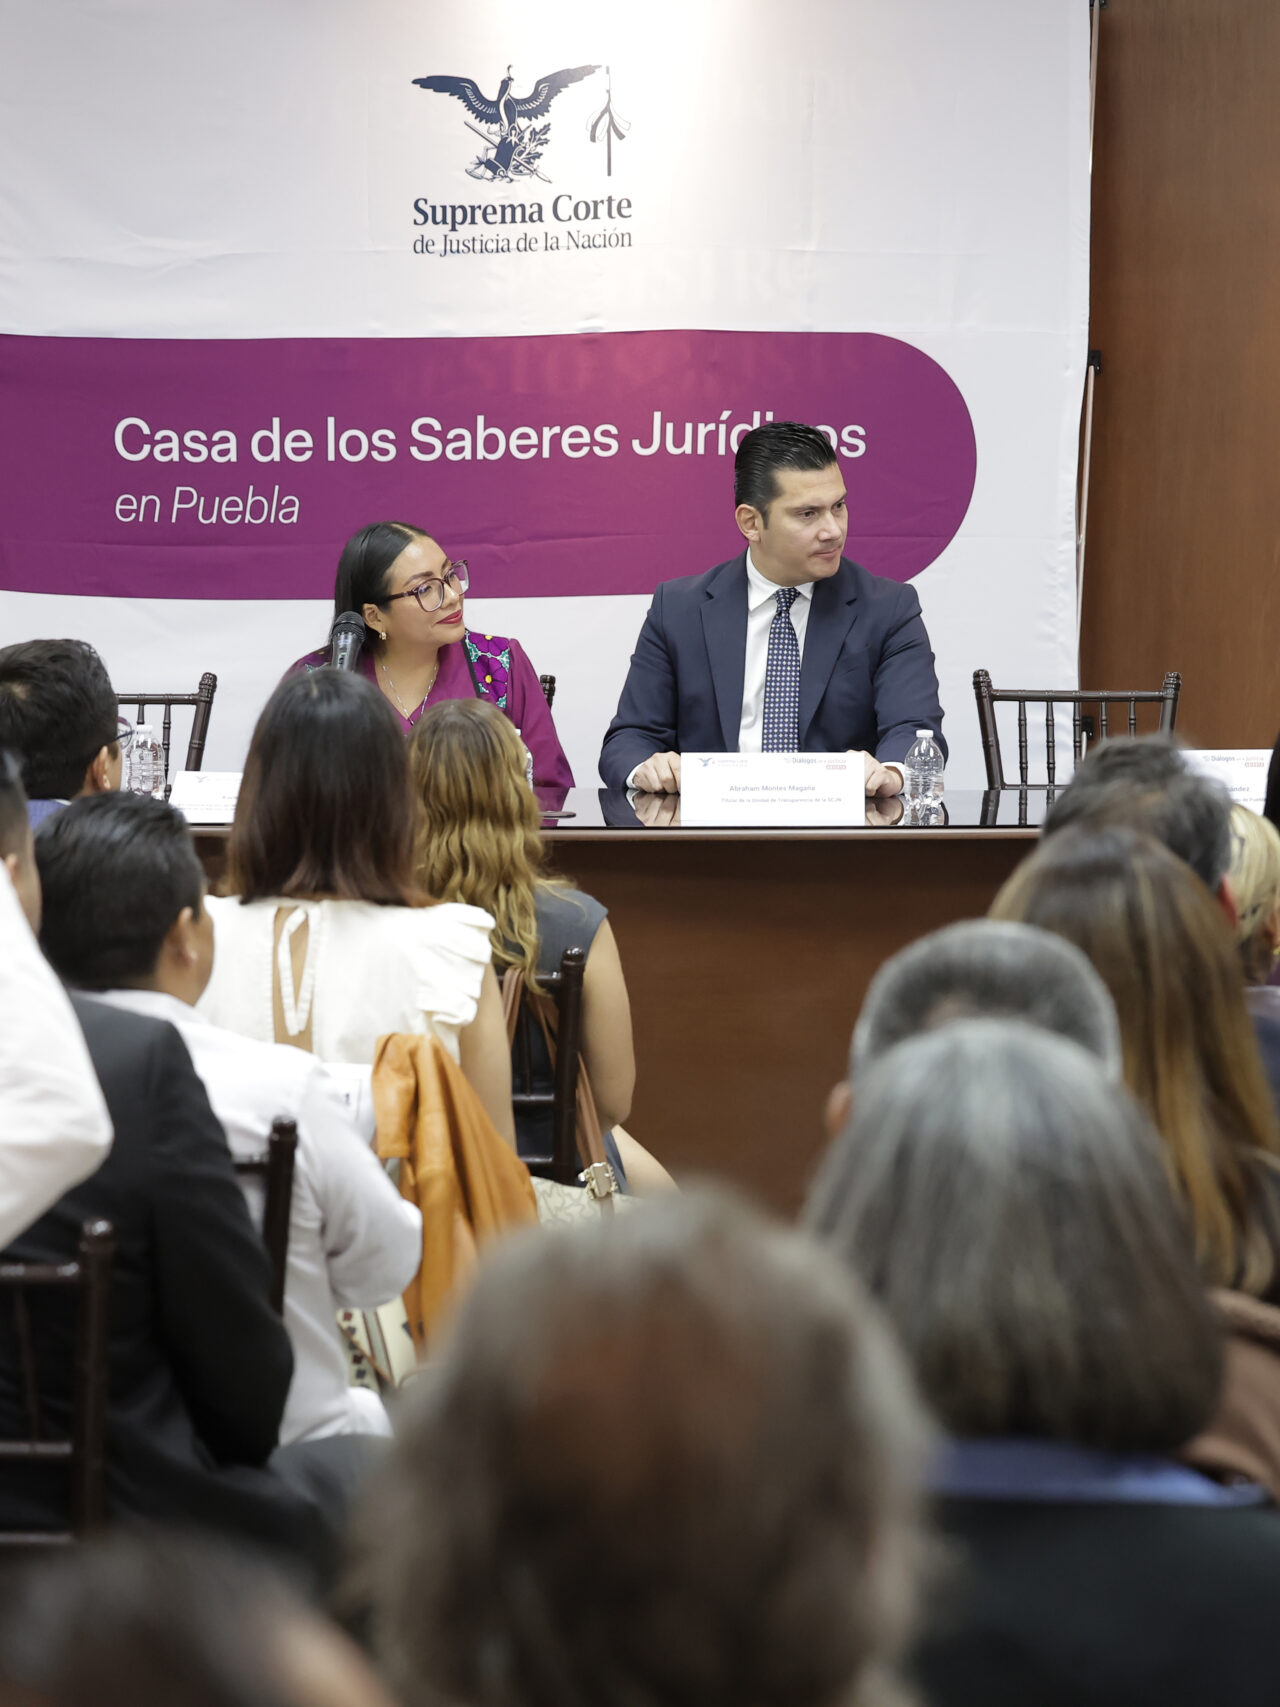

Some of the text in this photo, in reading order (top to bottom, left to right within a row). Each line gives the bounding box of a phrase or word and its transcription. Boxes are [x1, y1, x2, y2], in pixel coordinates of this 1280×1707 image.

[413, 194, 632, 232] Suprema Corte
[413, 227, 632, 257] de Justicia de la Nación
[113, 416, 238, 463] Casa
[250, 416, 314, 463] de
[326, 417, 397, 463] los
[409, 411, 619, 462] Saberes
[114, 487, 300, 525] en Puebla
